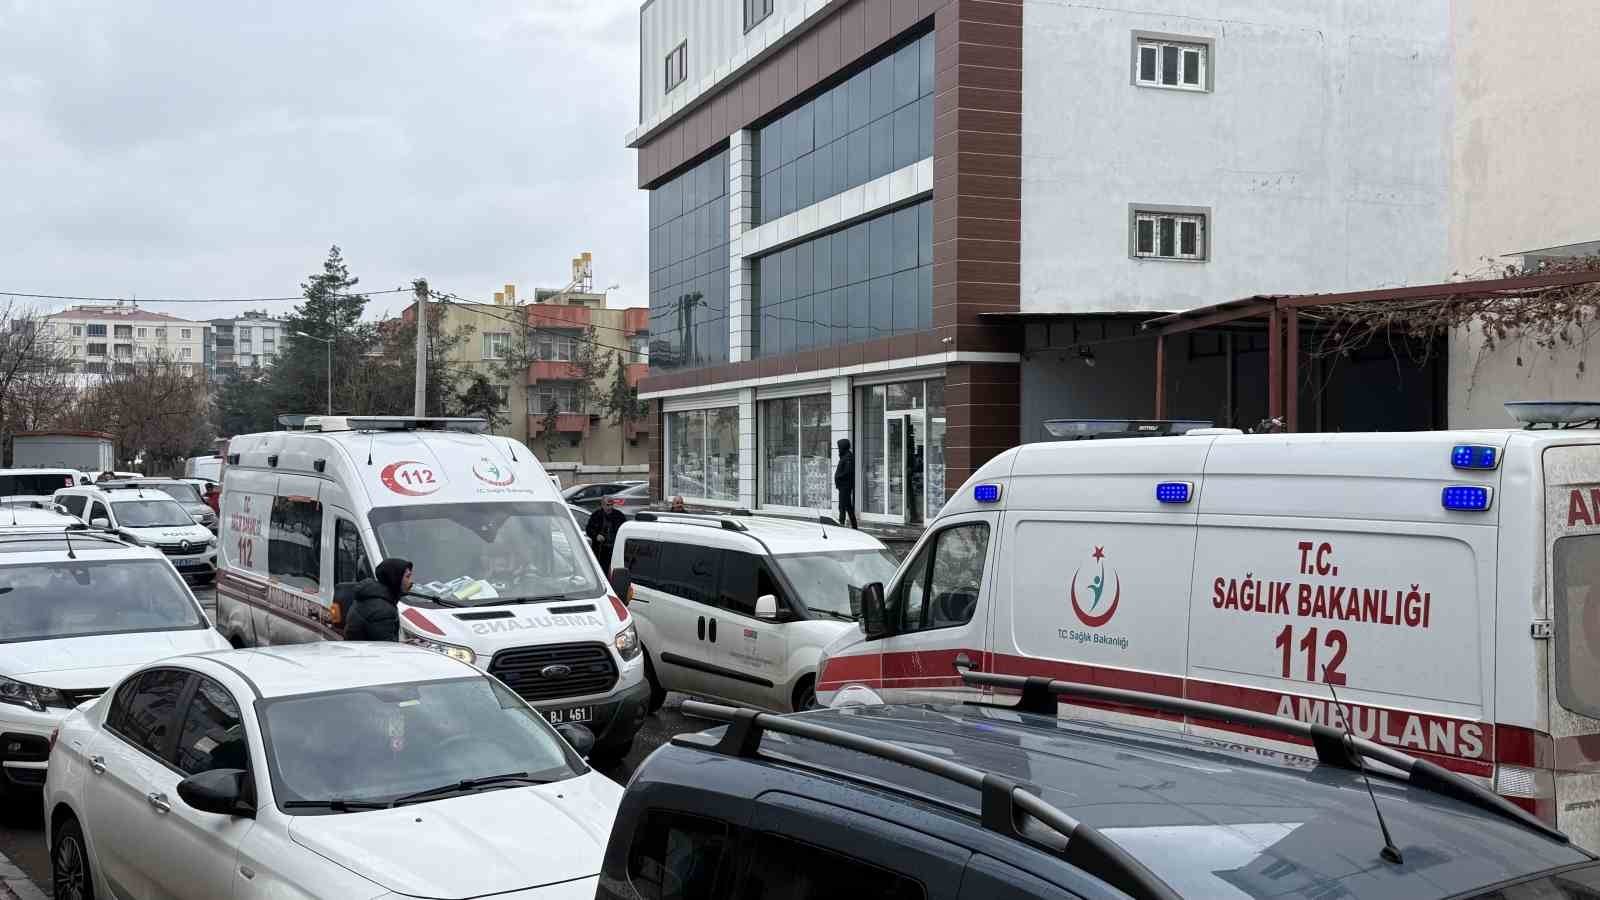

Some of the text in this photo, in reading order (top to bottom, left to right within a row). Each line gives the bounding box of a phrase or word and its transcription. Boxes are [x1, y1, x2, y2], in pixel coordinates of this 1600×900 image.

[401, 469, 436, 485] 112
[238, 537, 253, 568] 112
[1298, 541, 1338, 577] T.C.
[1212, 572, 1431, 628] SAĞLIK BAKANLIĞI
[1275, 624, 1347, 686] 112
[550, 707, 586, 724] BJ 461
[1276, 695, 1484, 759] AMBULANS
